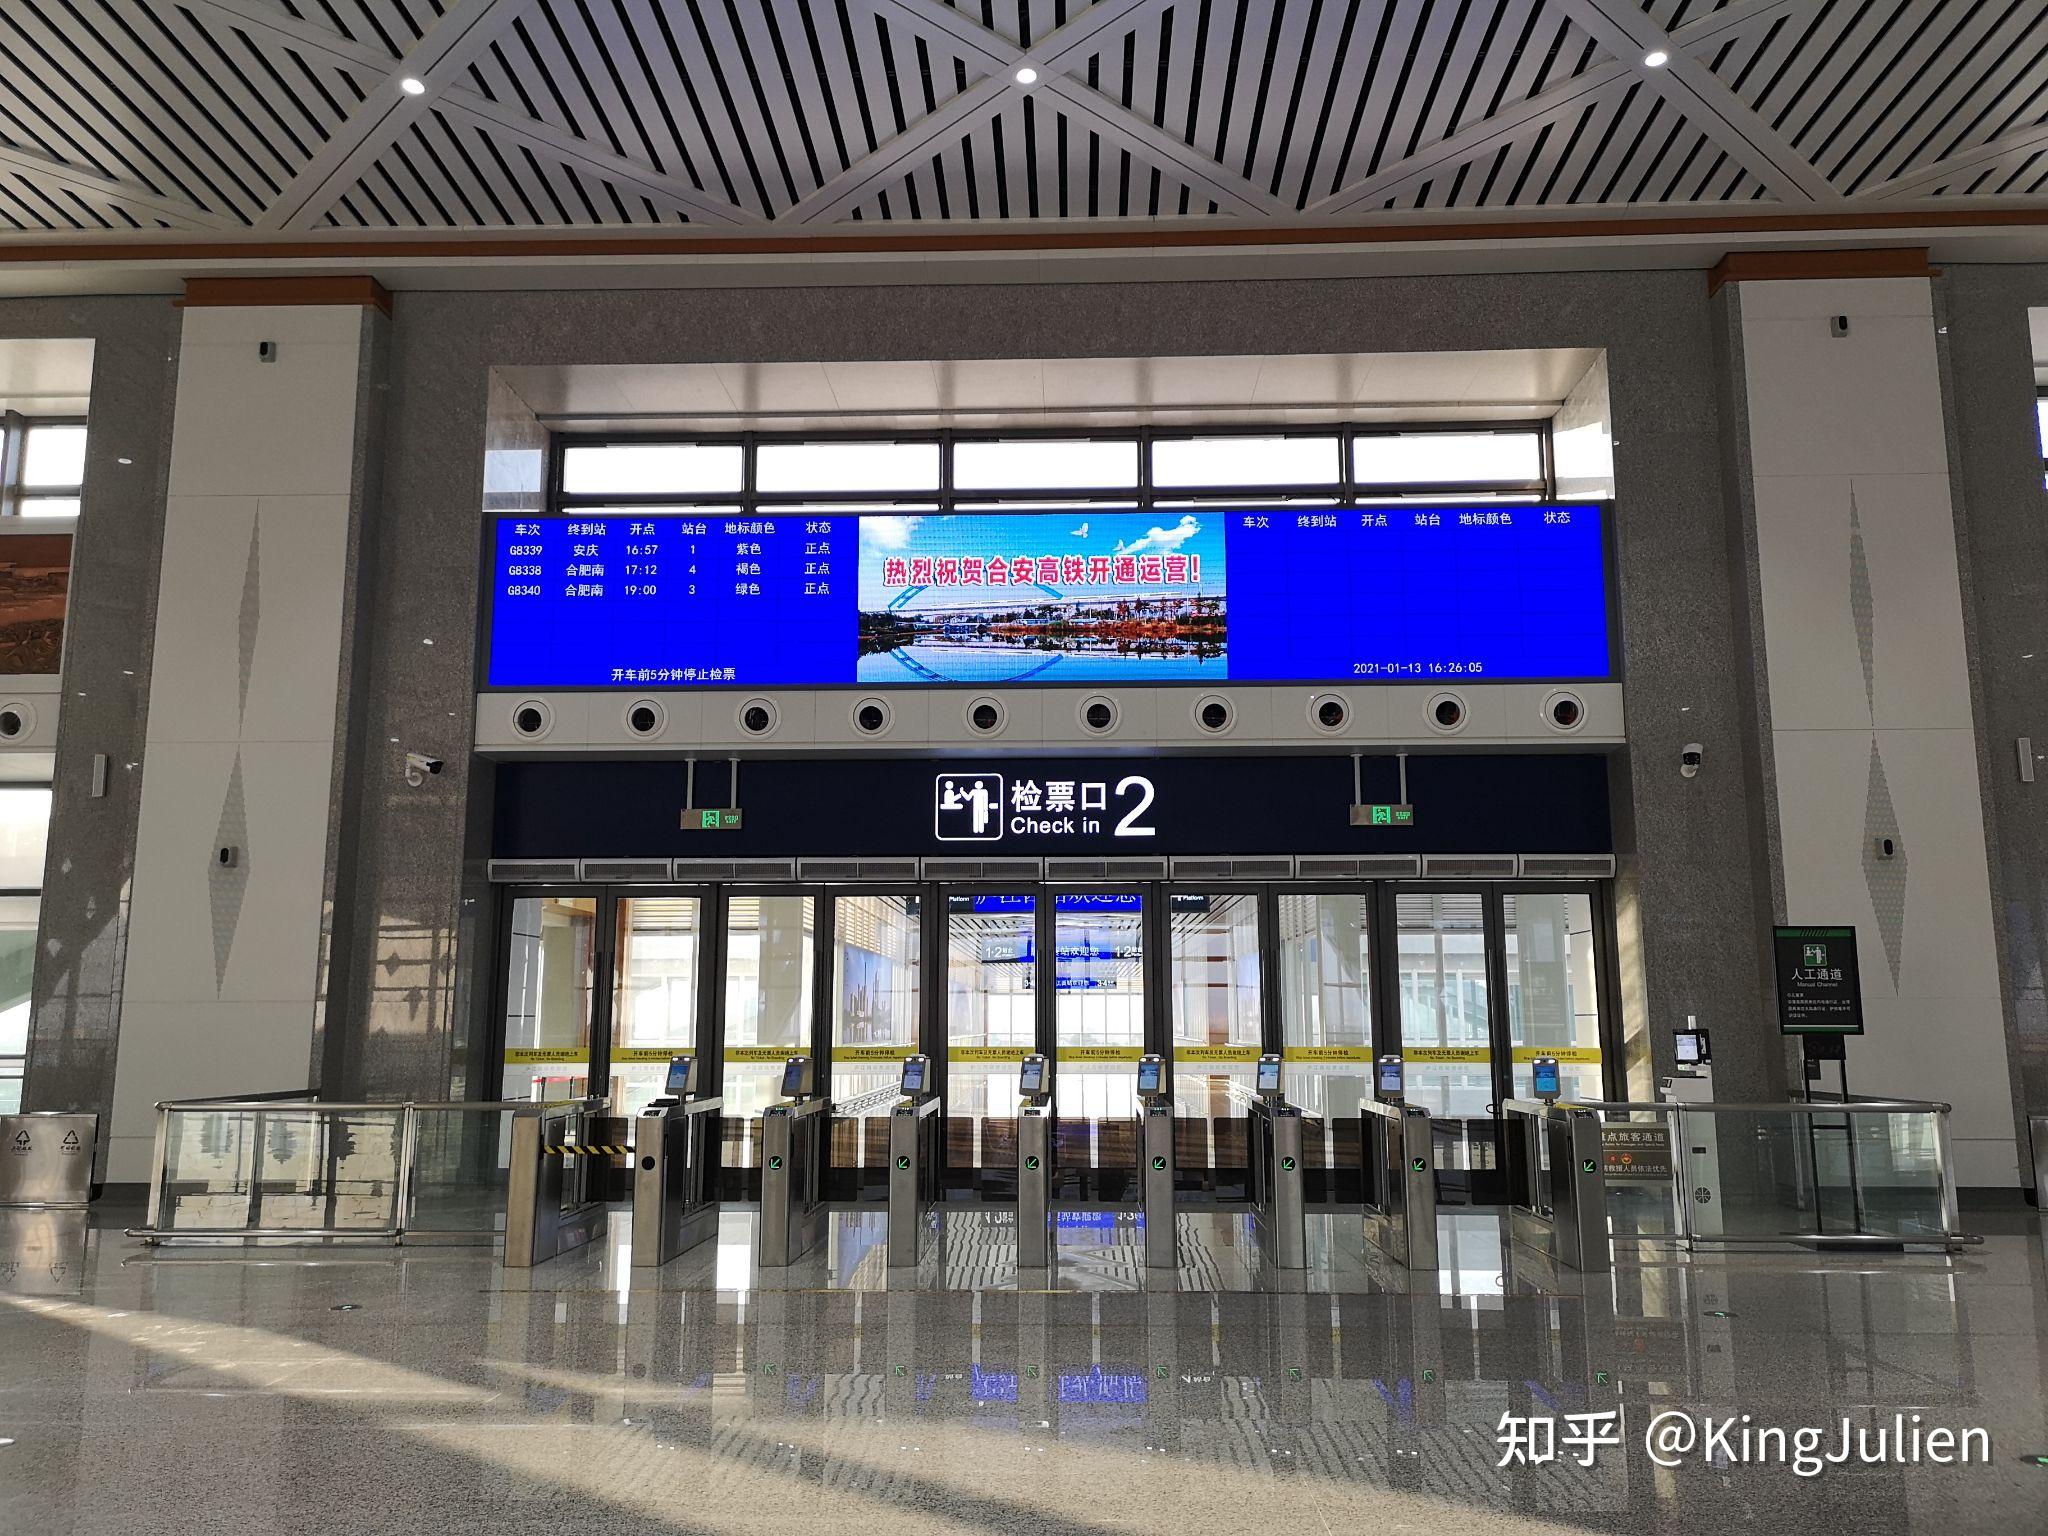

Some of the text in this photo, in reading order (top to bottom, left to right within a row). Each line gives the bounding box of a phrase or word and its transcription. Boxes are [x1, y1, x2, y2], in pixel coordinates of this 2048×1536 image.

[1243, 511, 1570, 529] 车次 终到站 开点 站台 地标颜色 状态
[515, 521, 831, 536] 车次 终到站 开点 站台 地标颜色 状态
[509, 542, 831, 557] G8339 安庆 16:57 1 紫色 正点
[508, 562, 830, 577] G8338 合肥南 17:12 4 褐色 正点
[507, 582, 830, 597] G8340 合肥南 19:00 3 绿色 正点
[611, 667, 736, 683] 开车前5分钟停止检票
[1353, 661, 1483, 674] 2021-01-13 16:26:05
[1010, 779, 1107, 812] 检票口
[1114, 775, 1156, 837] 2
[1010, 816, 1100, 834] Check in
[1791, 968, 1842, 980] 人工通道
